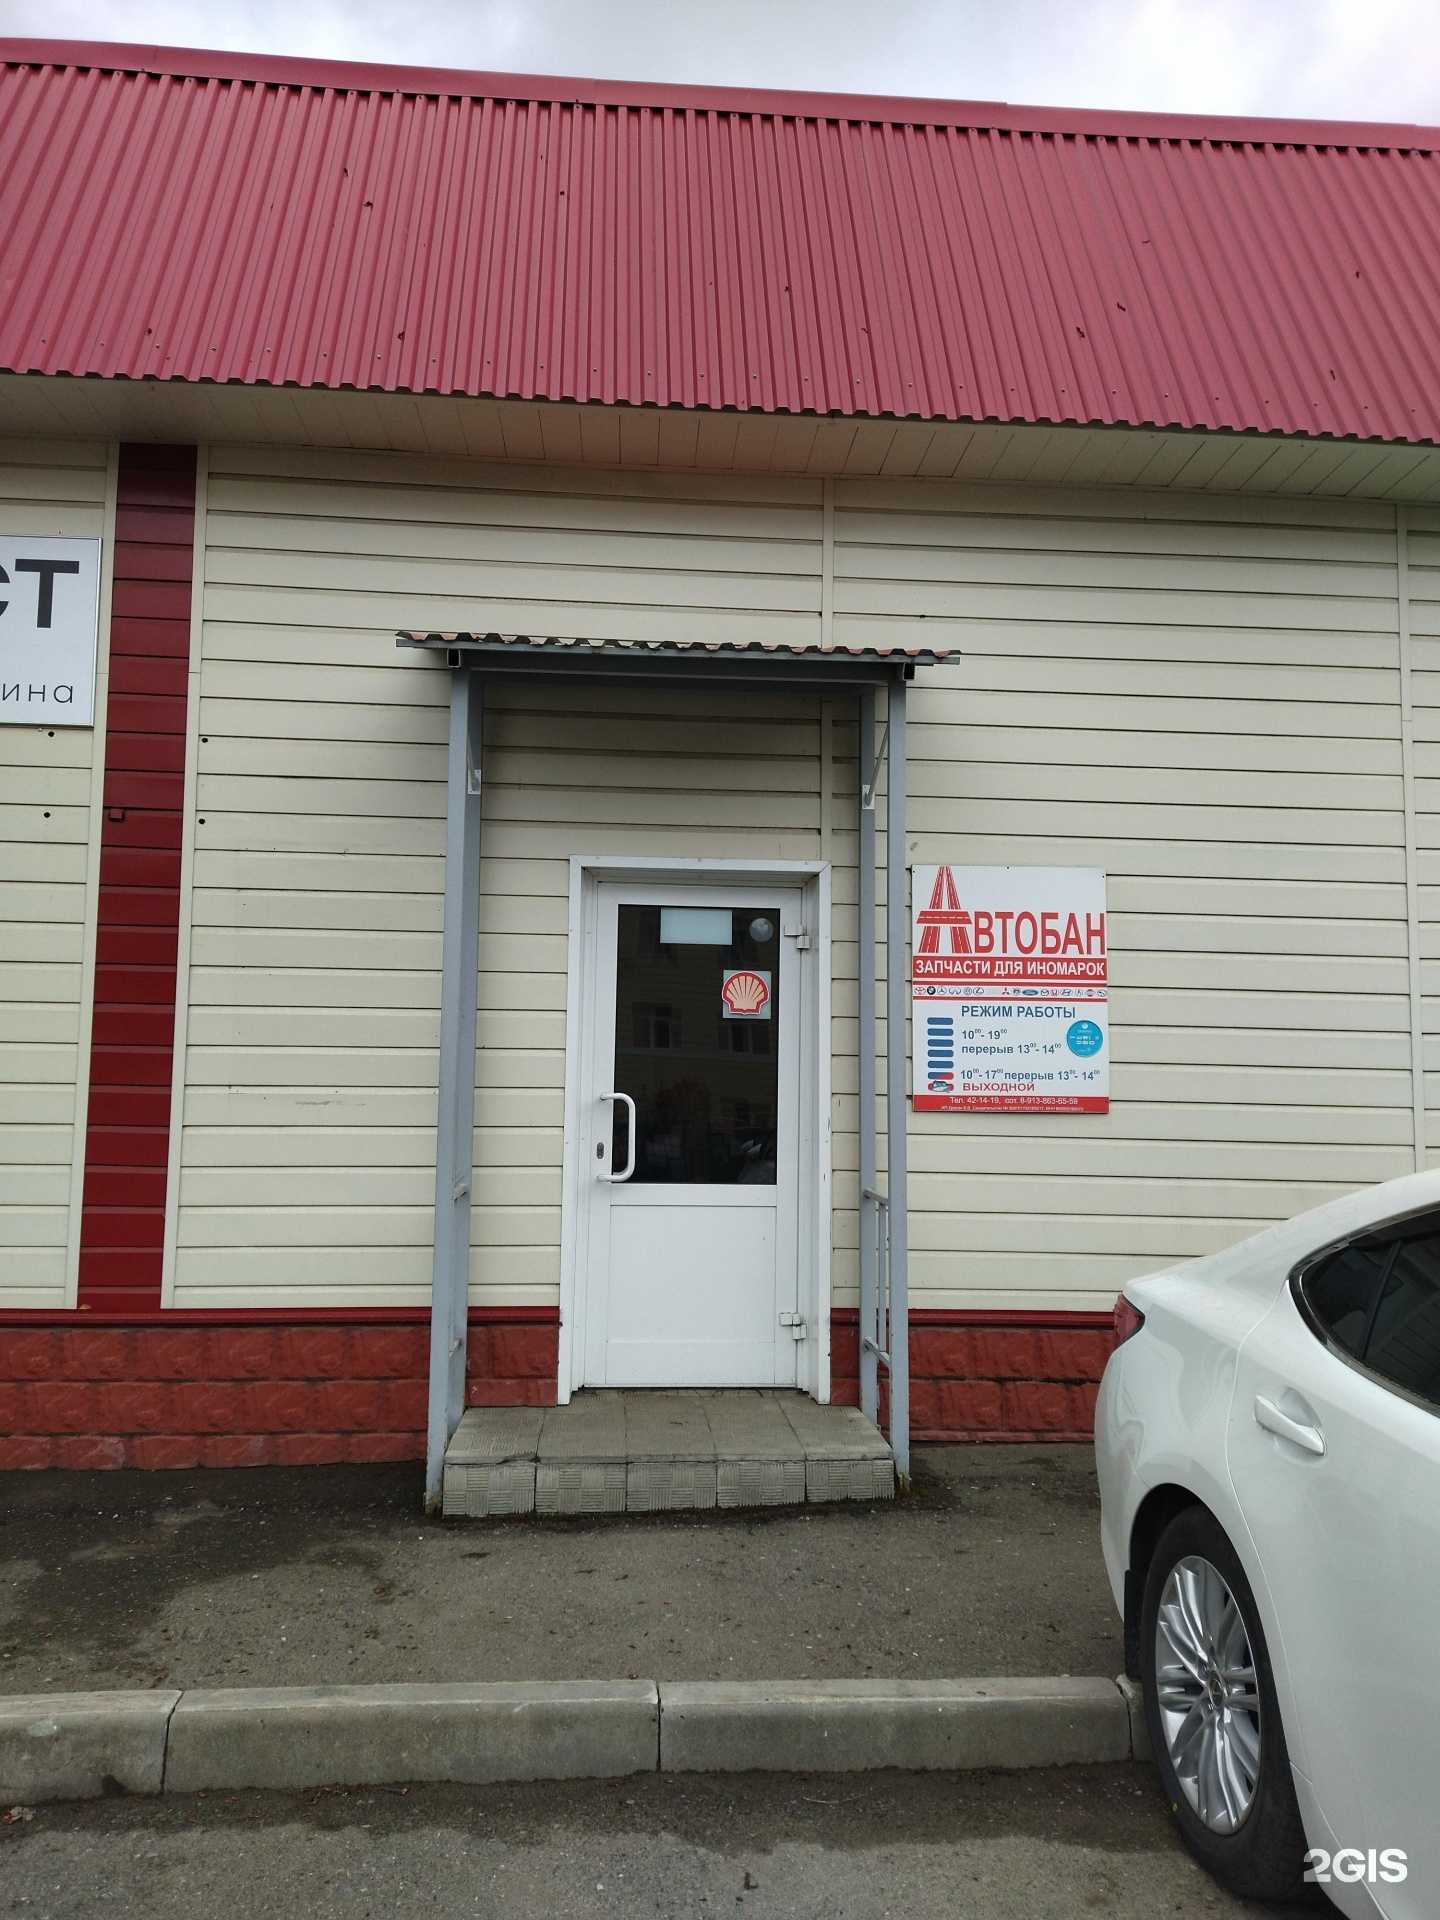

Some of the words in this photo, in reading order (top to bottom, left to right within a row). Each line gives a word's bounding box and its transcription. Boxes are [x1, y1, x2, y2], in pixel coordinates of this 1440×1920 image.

[916, 866, 1105, 955] АВТОБАН
[915, 960, 990, 975] ЗАПЧАСТИ
[994, 961, 1023, 977] ДЛЯ
[1027, 961, 1105, 976] ИНОМАРОК
[961, 1005, 1012, 1017] РЕЖИМ
[1017, 1006, 1076, 1019] РАБОТЫ
[961, 1045, 1014, 1056] перерыв
[1004, 1071, 1054, 1082] перерыв
[962, 1082, 1035, 1092] ВЫХОДНОЙ
